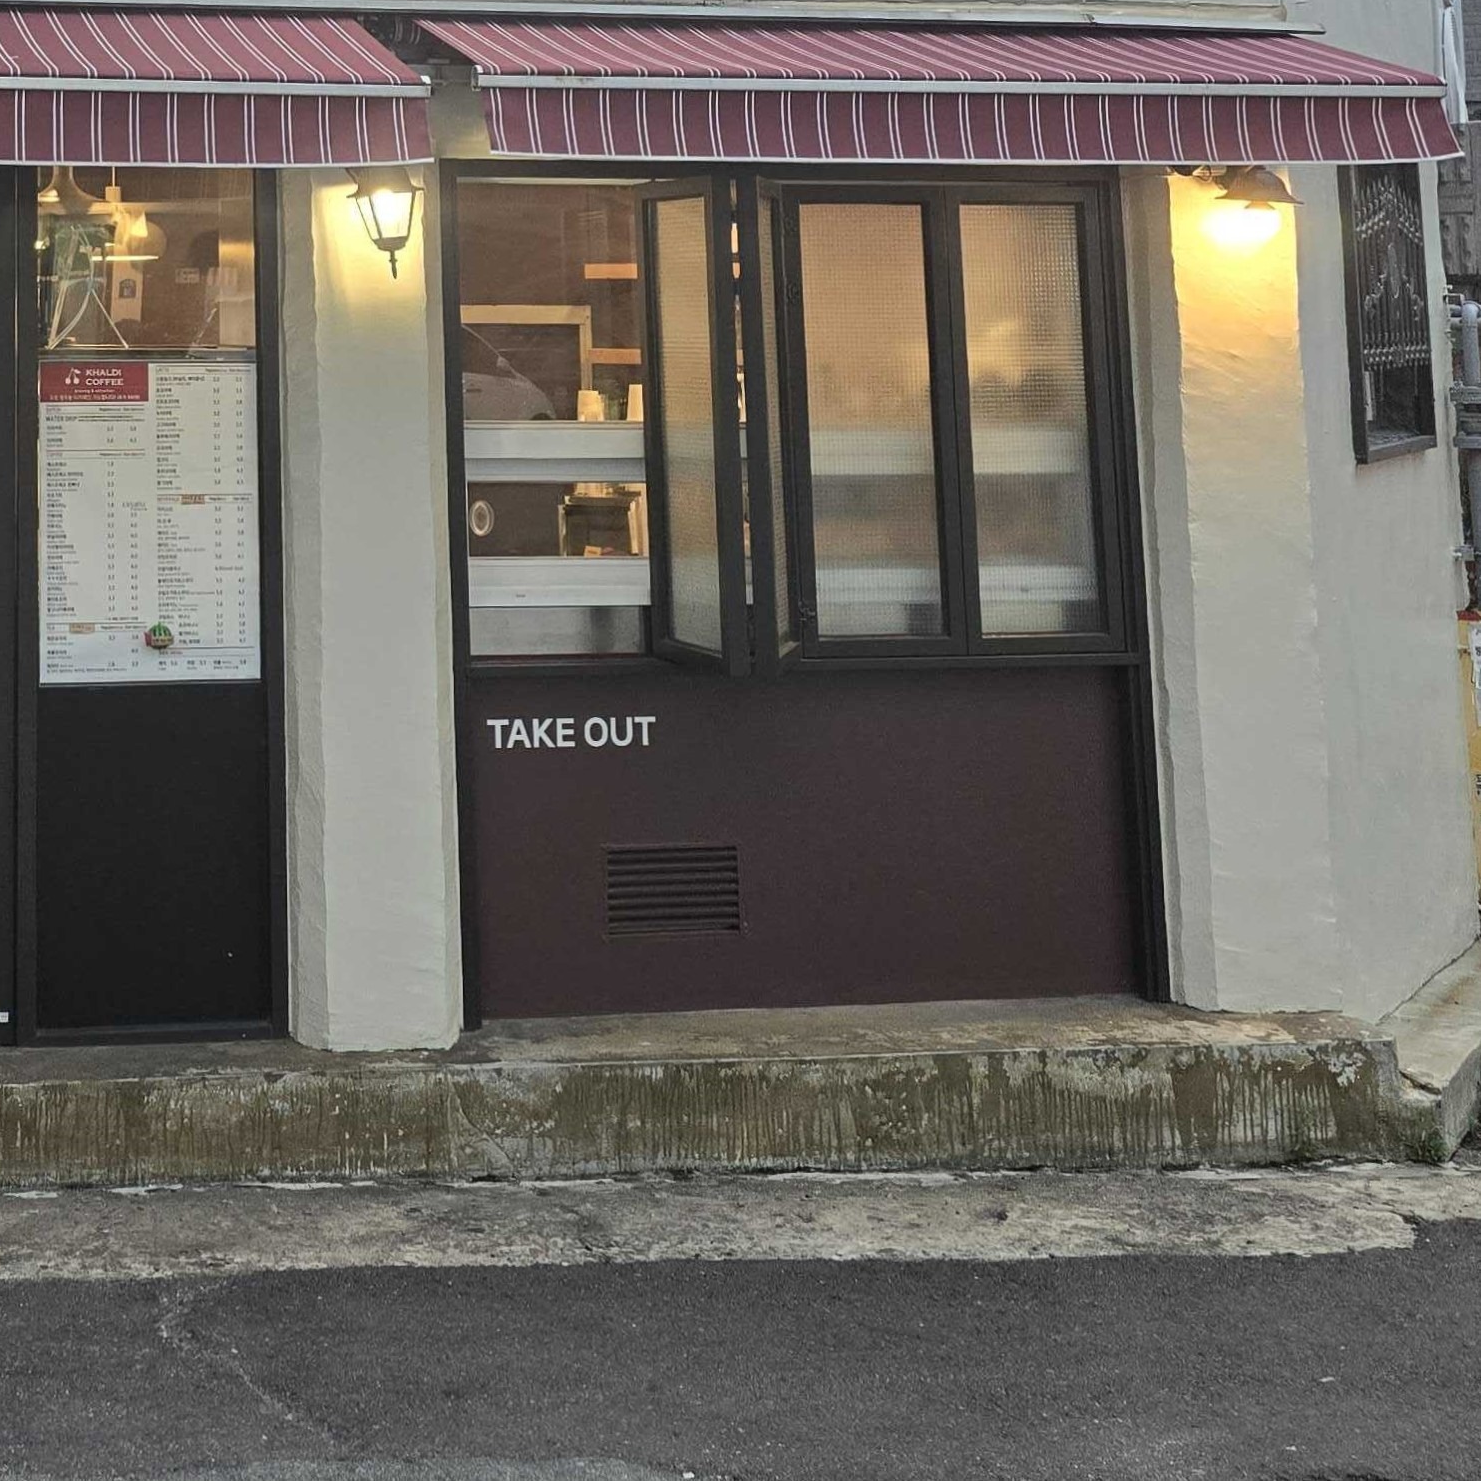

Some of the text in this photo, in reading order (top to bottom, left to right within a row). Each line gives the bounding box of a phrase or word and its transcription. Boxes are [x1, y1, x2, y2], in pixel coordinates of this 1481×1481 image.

[85, 368, 122, 377] KHALDI
[85, 378, 124, 386] COFFEE
[486, 716, 656, 749] TAKE OUT
